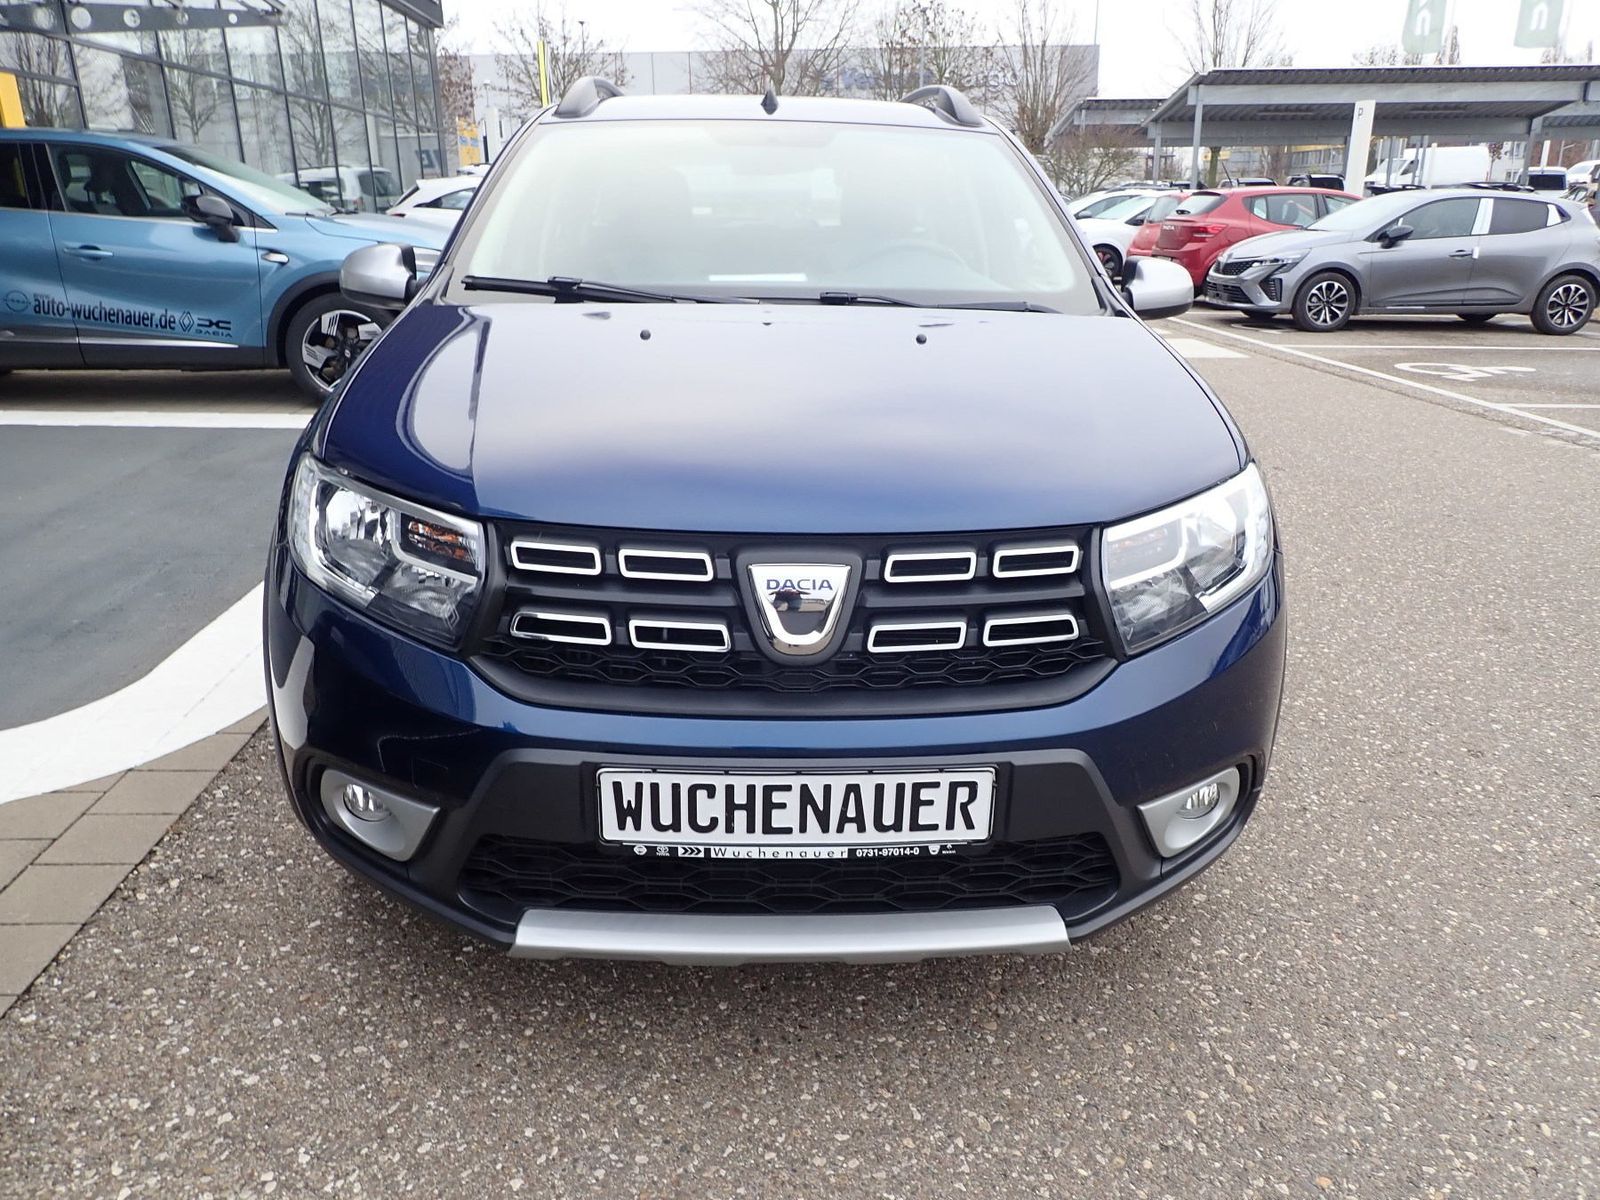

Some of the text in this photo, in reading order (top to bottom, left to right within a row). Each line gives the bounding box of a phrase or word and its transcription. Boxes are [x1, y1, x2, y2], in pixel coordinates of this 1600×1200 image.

[33, 297, 176, 331] auto-wuchenauer.de
[766, 578, 833, 591] DACIA
[611, 780, 978, 835] WUCHENAUER
[713, 846, 920, 859] Wuchenauer 0731-97014-0
